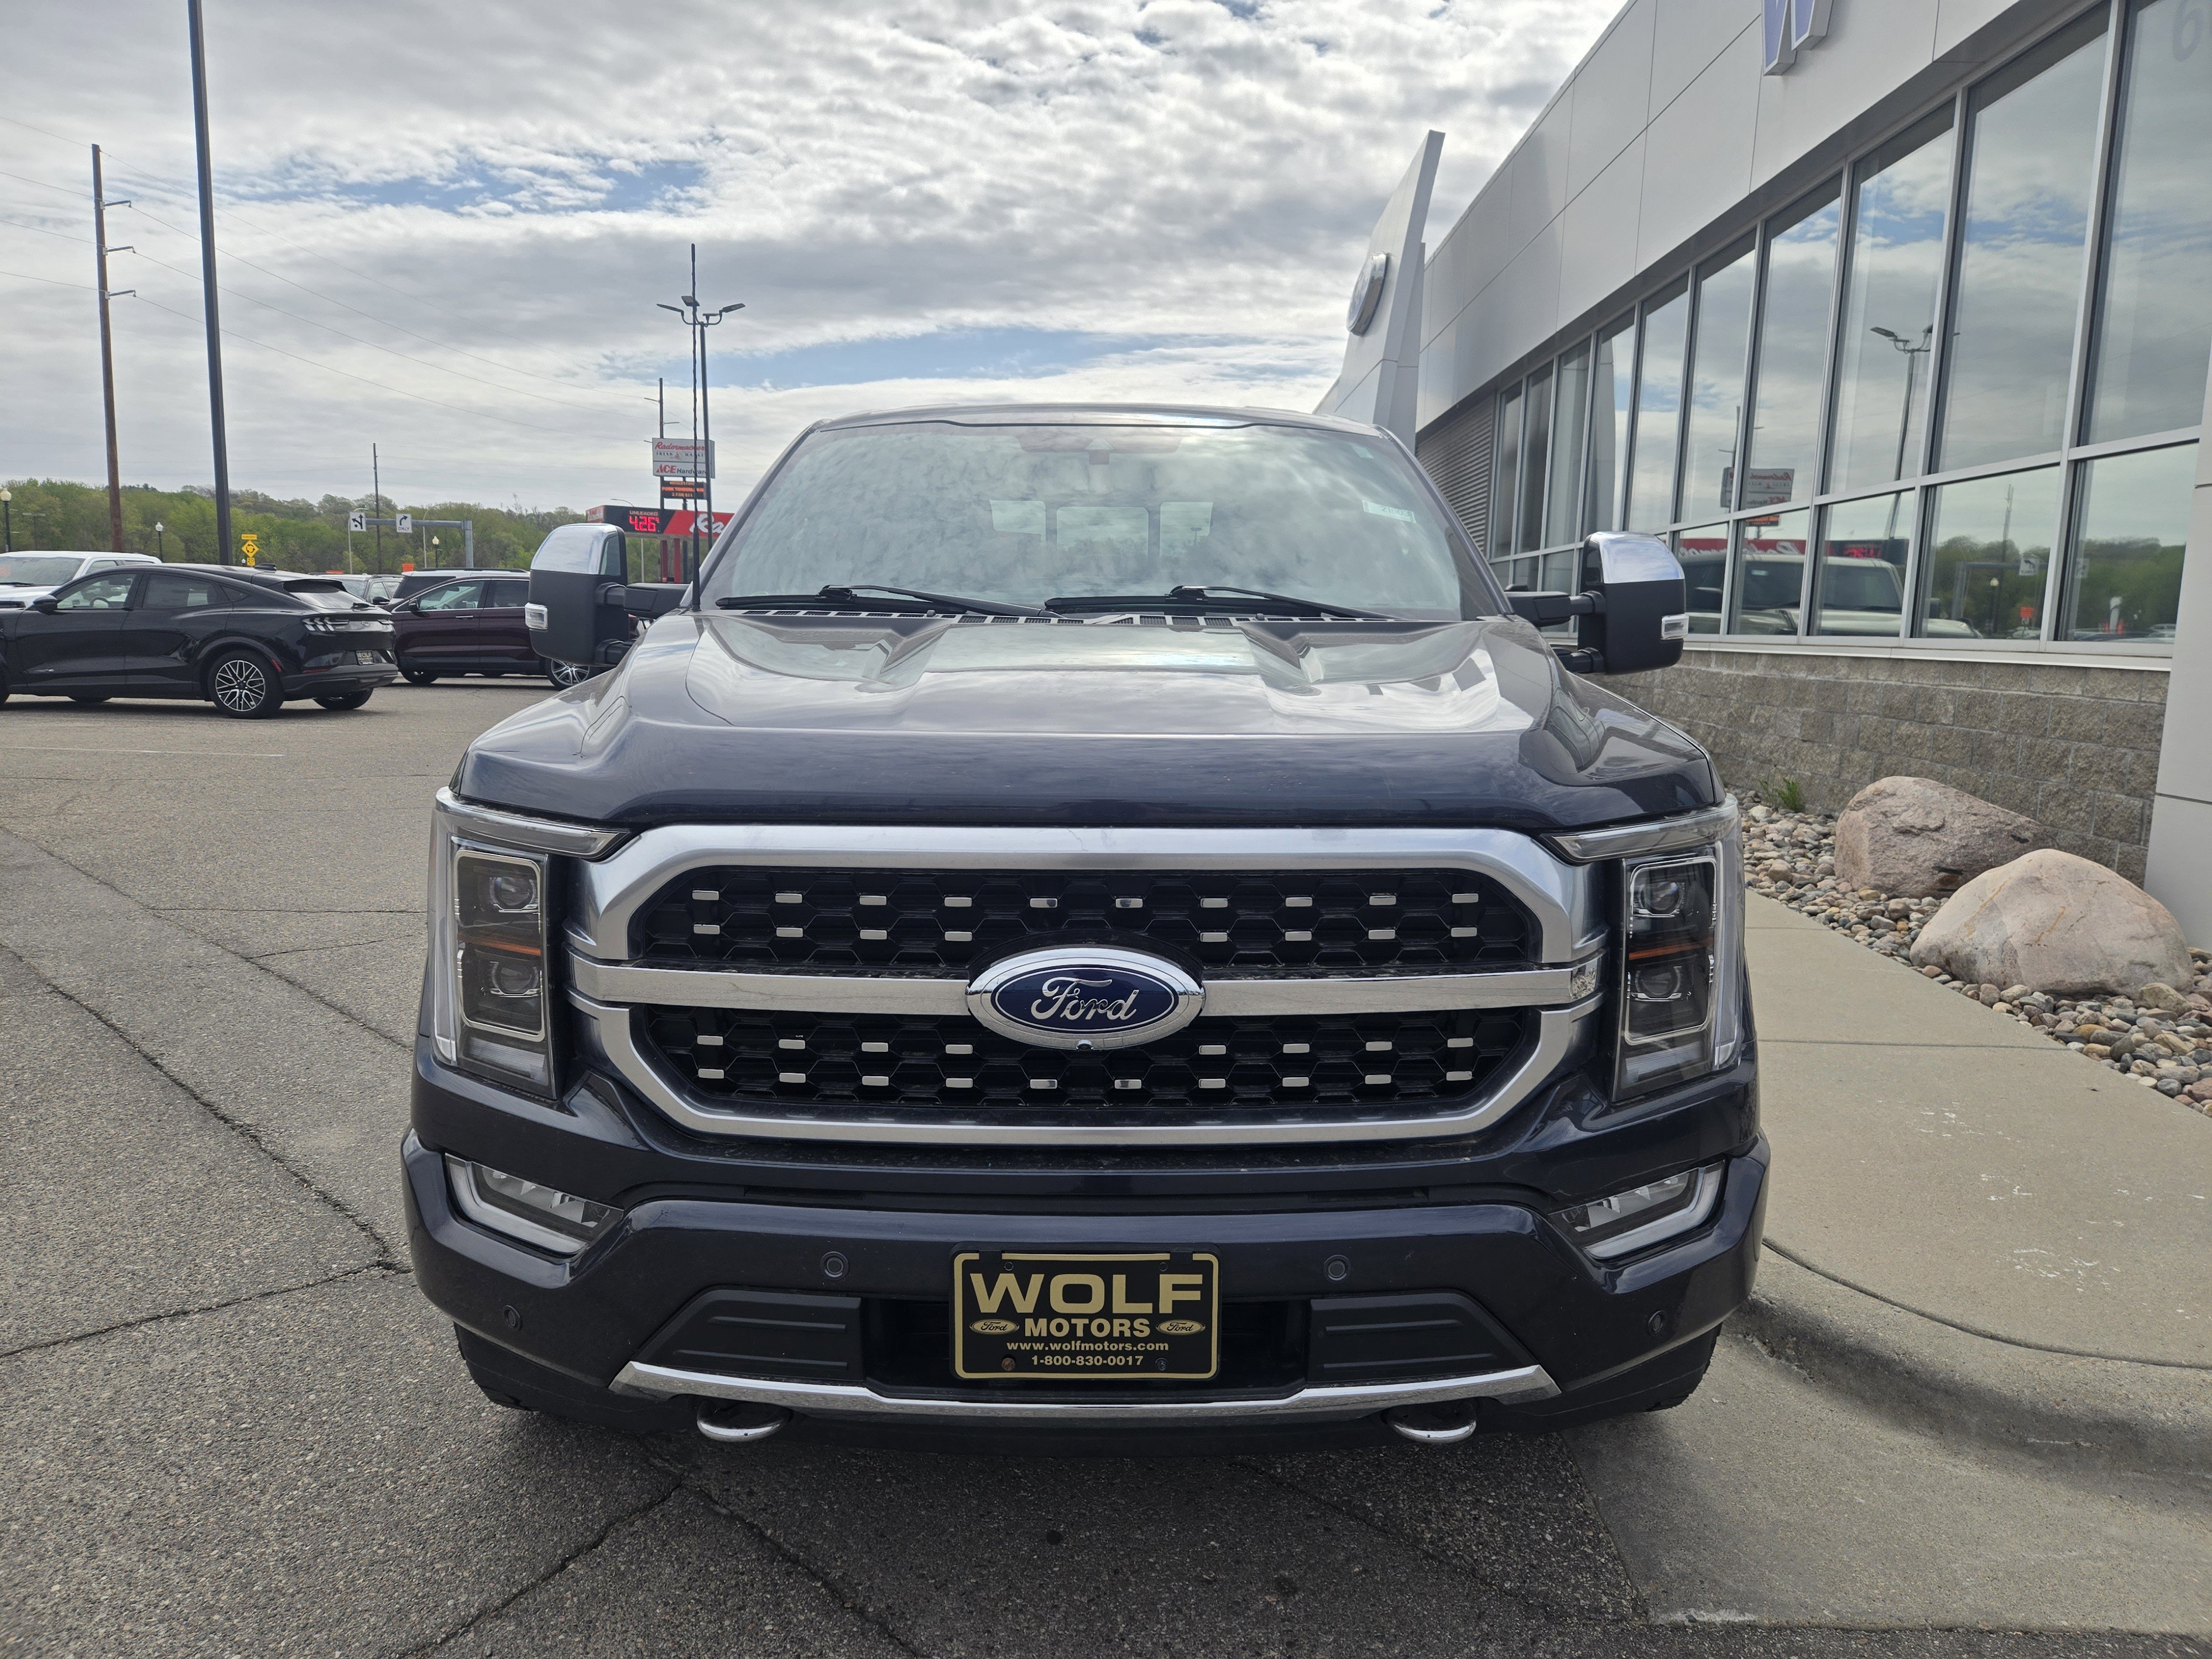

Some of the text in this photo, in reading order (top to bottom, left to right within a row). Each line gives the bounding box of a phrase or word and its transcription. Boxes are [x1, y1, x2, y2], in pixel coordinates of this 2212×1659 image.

[656, 463, 677, 473] ACE
[1030, 977, 1137, 1020] Ford
[969, 1273, 1203, 1314] WOLF
[980, 1321, 1008, 1332] Ford
[1025, 1318, 1151, 1338] MOTORS
[1166, 1322, 1193, 1332] Ford
[1006, 1340, 1169, 1351] www.wolfmotors.com
[1031, 1355, 1144, 1366] 1-800-830-0017
